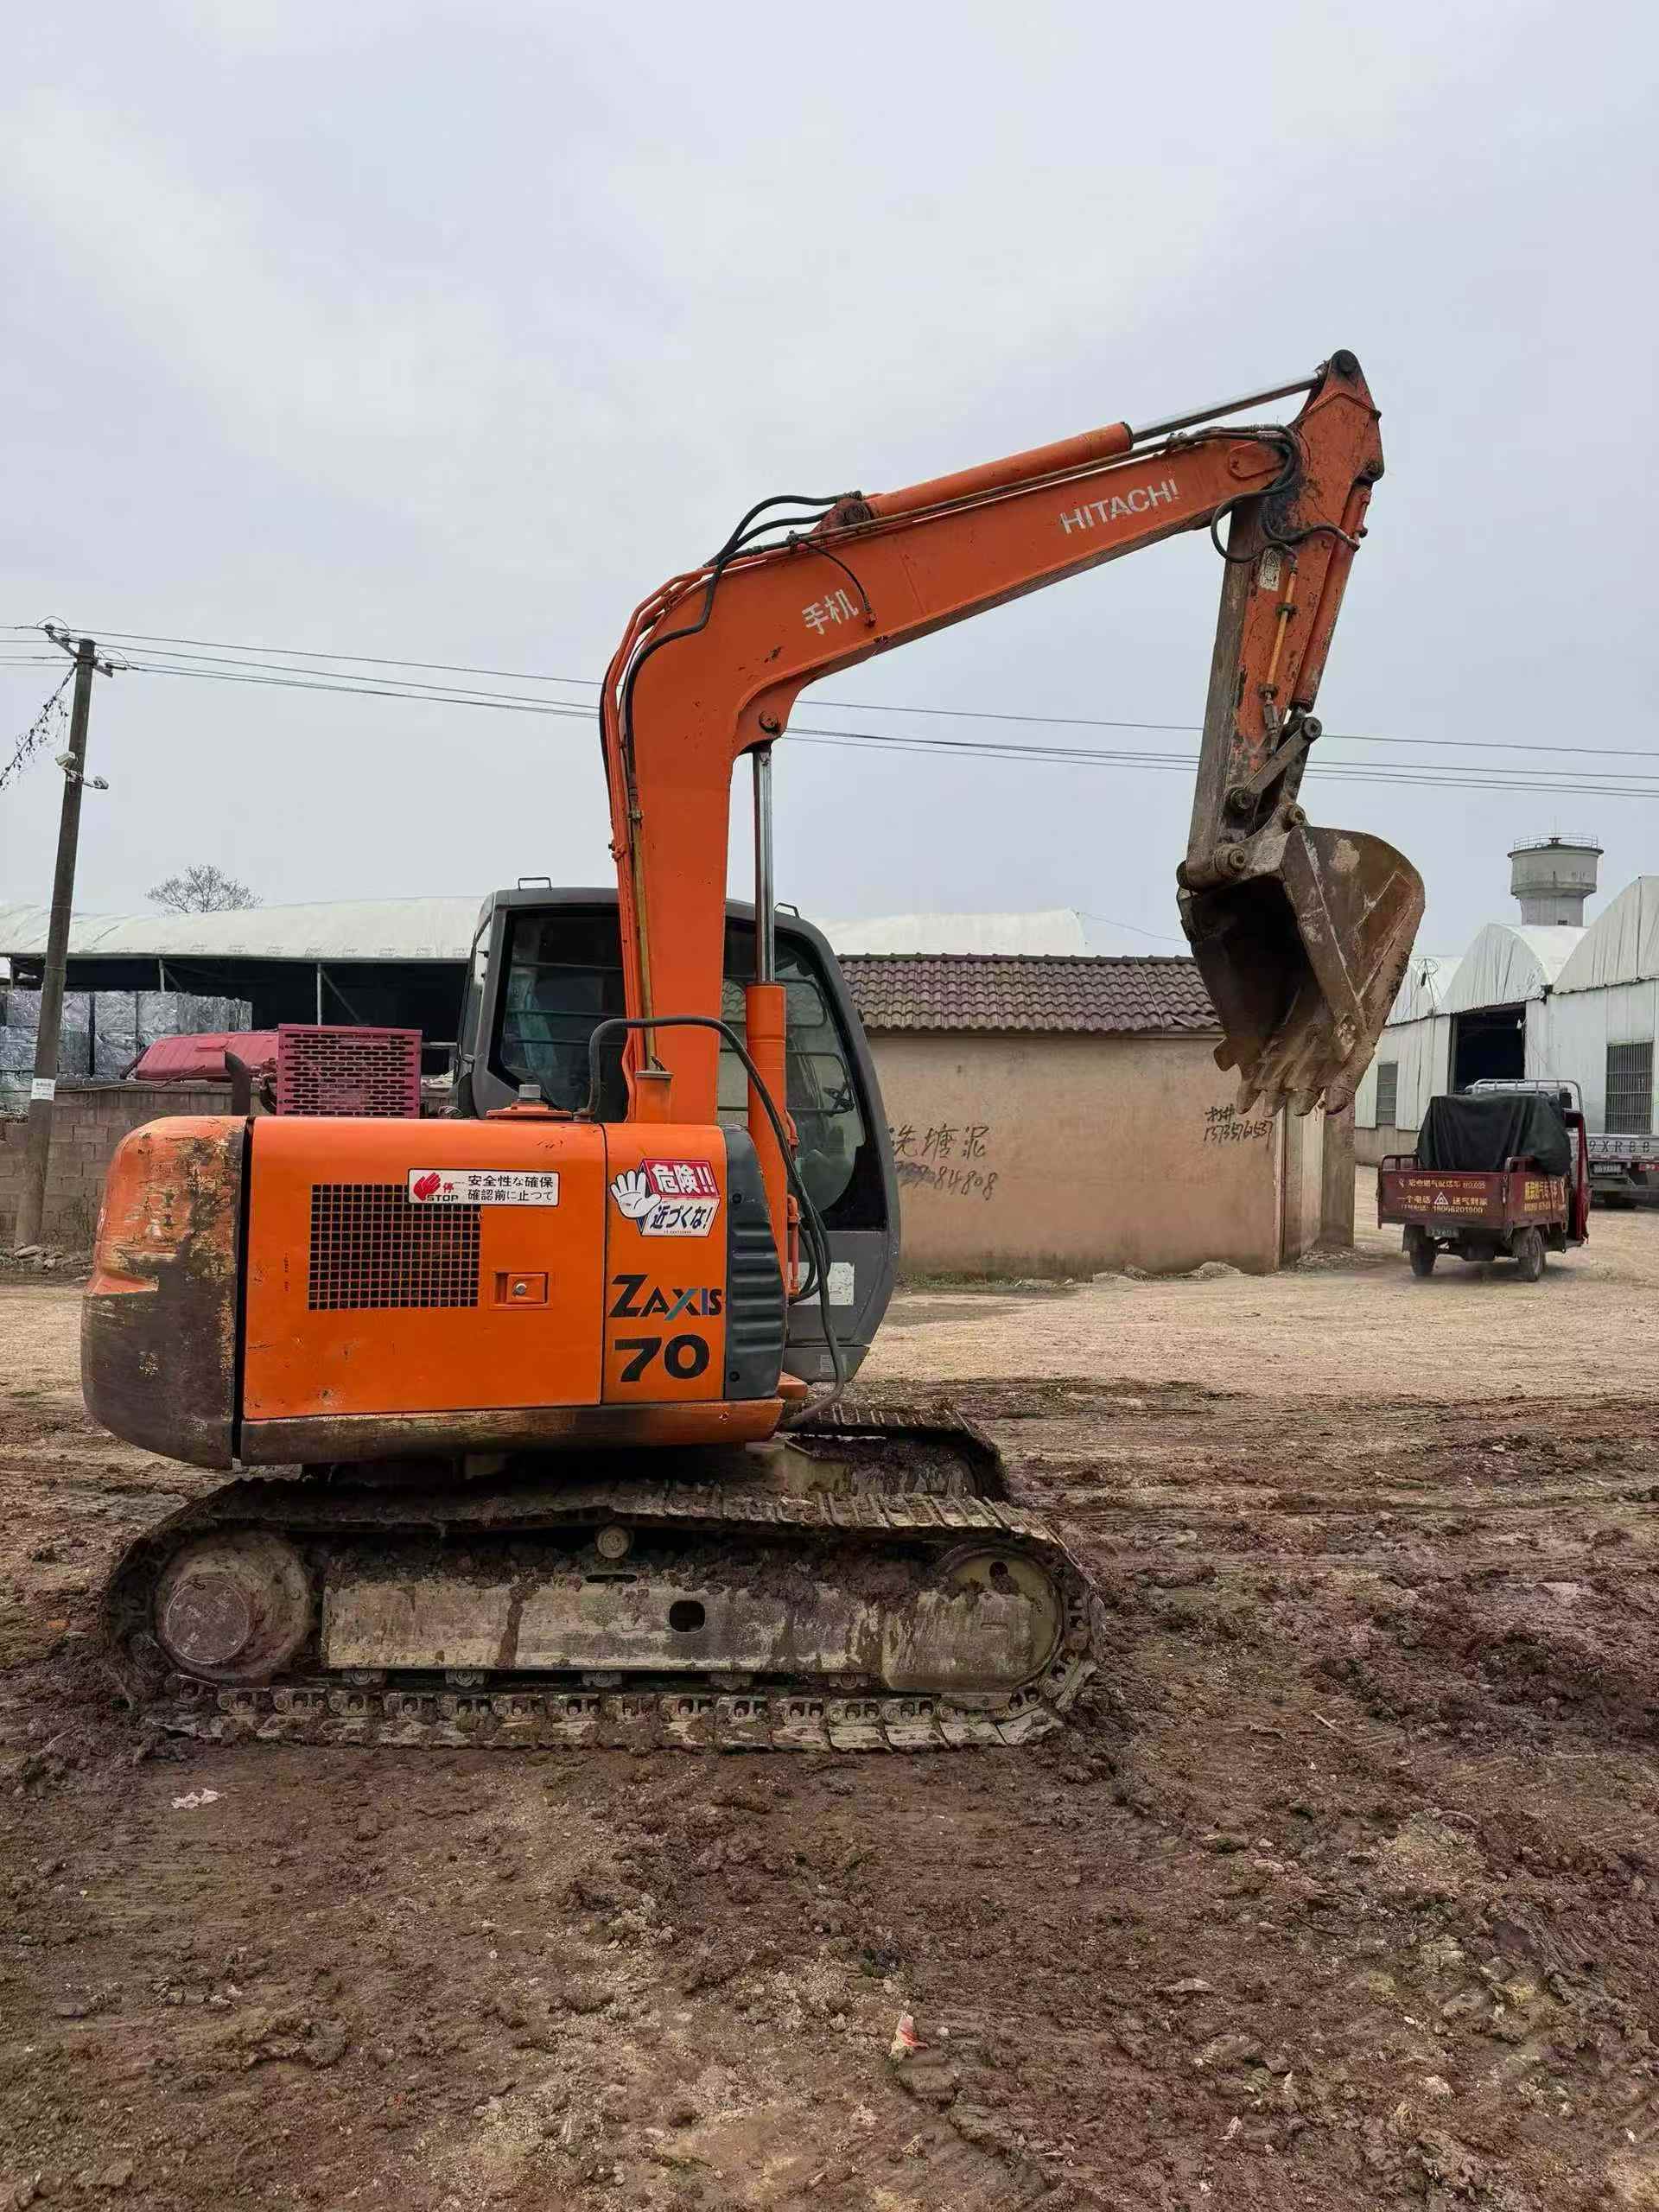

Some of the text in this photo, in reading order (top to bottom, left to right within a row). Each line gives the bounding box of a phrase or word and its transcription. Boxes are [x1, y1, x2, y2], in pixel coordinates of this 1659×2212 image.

[1059, 478, 1180, 535] HITACHI
[802, 589, 858, 635] 手机
[467, 1174, 554, 1188] 安全性な確保
[608, 1274, 722, 1320] ZAXIS
[614, 1334, 710, 1382] 70
